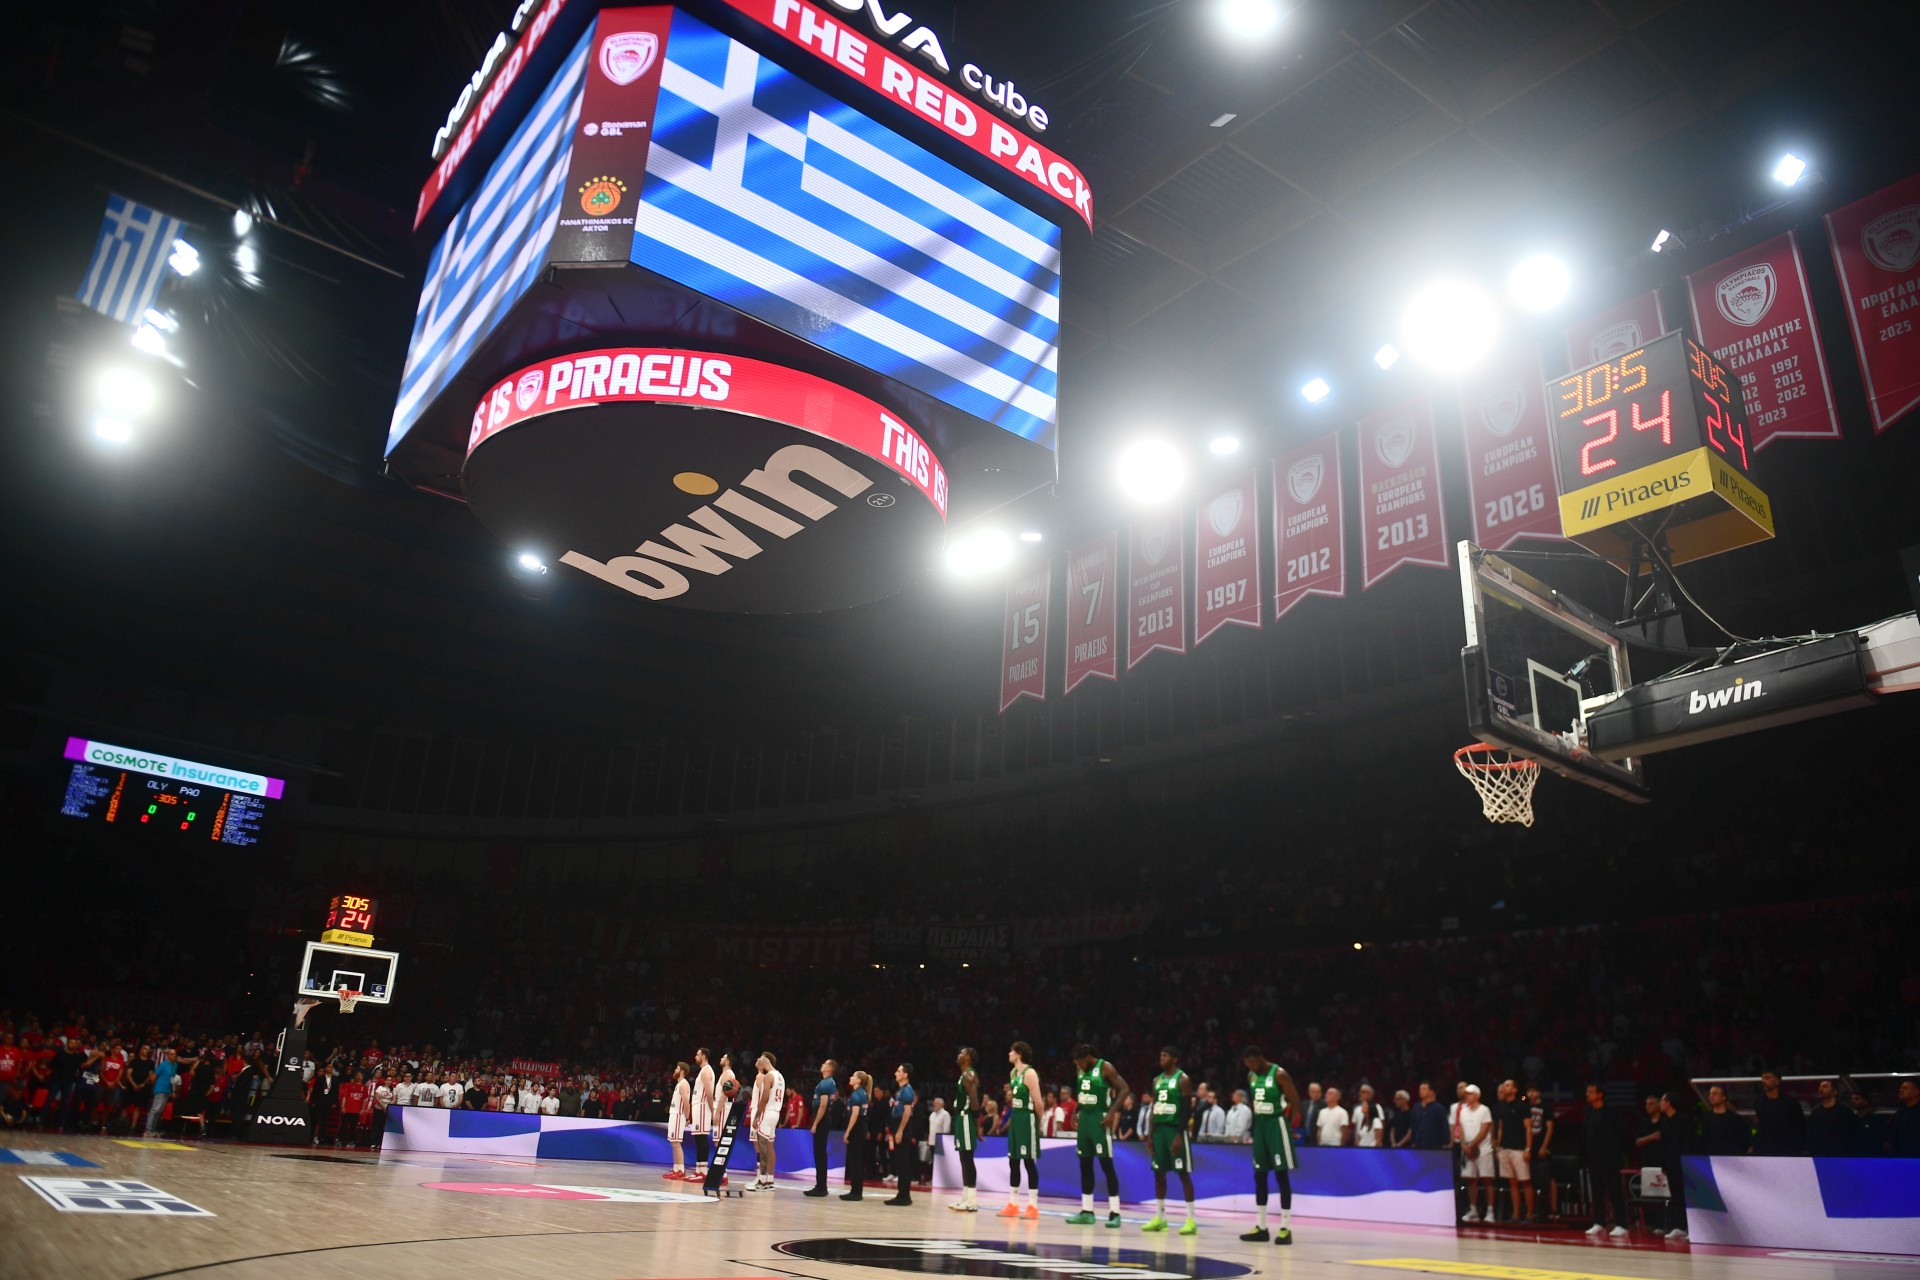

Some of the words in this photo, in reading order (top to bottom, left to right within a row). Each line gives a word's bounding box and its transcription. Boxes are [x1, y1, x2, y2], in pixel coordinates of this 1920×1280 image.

[832, 0, 950, 72] VA
[962, 63, 1049, 131] cube
[431, 31, 507, 158] NOVA
[772, 0, 868, 77] THE
[882, 56, 977, 138] RED
[990, 122, 1093, 226] PACK
[437, 115, 476, 190] THE
[560, 218, 621, 226] PANATHINAIKOS
[1721, 267, 1766, 291] OLYMPIACOS
[1728, 276, 1761, 292] BASKETBALL
[1880, 320, 1913, 343] 2025
[1730, 337, 1790, 369] ΕΛΛΑΔΑΣ
[1560, 349, 1648, 418] 30:5
[1740, 372, 1757, 387] 96
[1771, 355, 1799, 376] 1997
[1774, 371, 1803, 390] 2015
[1777, 384, 1807, 405] 2022
[1703, 392, 1748, 471] 24
[1758, 407, 1788, 427] 2023
[1581, 390, 1672, 475] 24
[880, 412, 930, 488] THIS
[933, 463, 945, 512] IS
[1483, 446, 1538, 476] CHAMPIONS
[1484, 435, 1534, 463] EUROPEAN
[1376, 490, 1426, 516] CHAMPIONS
[1377, 479, 1423, 503] EUROPEAN
[1484, 483, 1545, 528] 2026
[1605, 470, 1692, 512] Piraeus
[1730, 475, 1767, 519] Piraeus
[558, 445, 874, 601] bwin
[1286, 514, 1329, 538] CHAMPIONS
[1288, 504, 1327, 527] EUROPEAN
[1377, 513, 1429, 551] 2013
[1207, 547, 1246, 568] CHAMPIONS
[1209, 537, 1245, 558] EUROPEAN
[1287, 547, 1330, 583] 2012
[1082, 580, 1101, 625] 7
[1138, 587, 1173, 606] CHAMPIONS
[1206, 578, 1247, 612] 1997
[1011, 602, 1041, 650] 15
[1138, 606, 1174, 637] 2013
[1074, 635, 1108, 664] PIRAEUS
[1009, 658, 1038, 684] PIRAEUS
[1688, 677, 1763, 714] bwin
[91, 749, 169, 773] COSMOTE
[171, 762, 261, 791] Insurance
[147, 780, 168, 791] OLY
[179, 786, 200, 797] PAO
[141, 814, 149, 823] 0
[180, 821, 189, 830] 0
[148, 804, 157, 814] 0
[187, 812, 195, 821] 0
[340, 910, 372, 930] 24
[256, 1115, 306, 1127] NOVA
